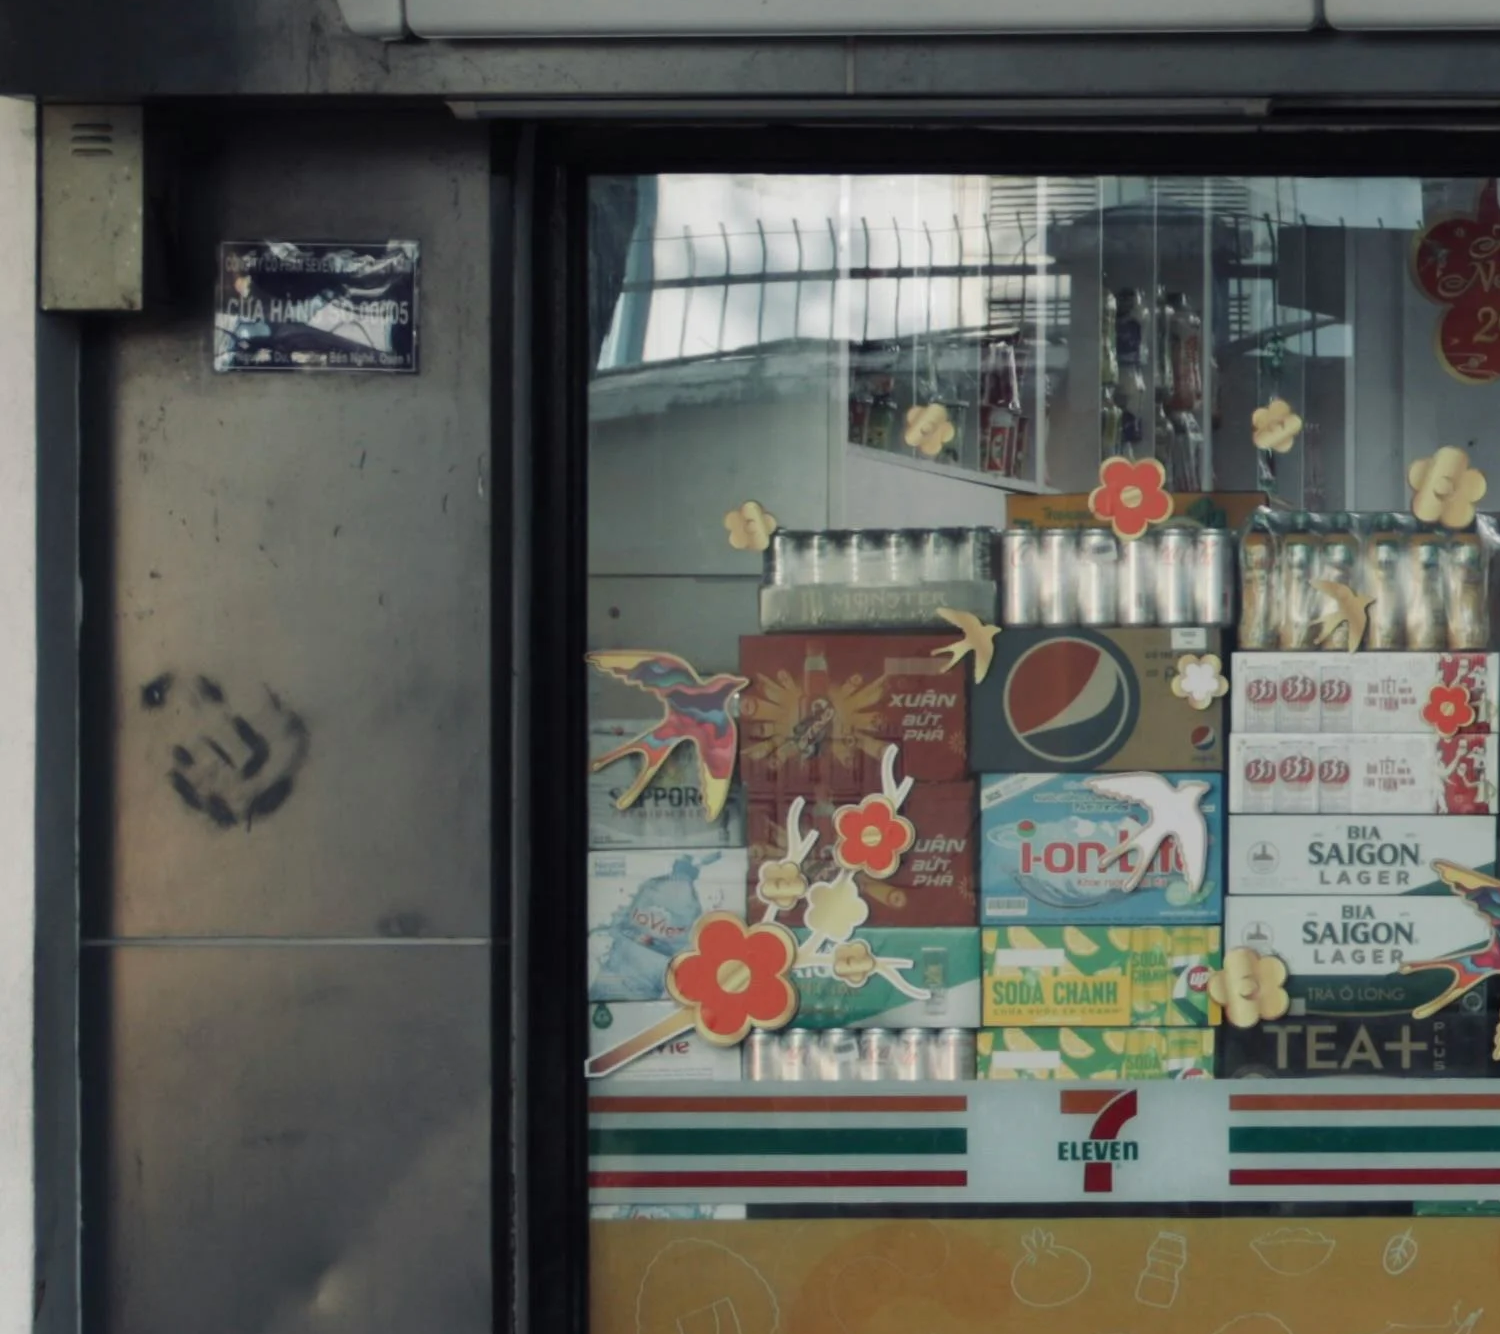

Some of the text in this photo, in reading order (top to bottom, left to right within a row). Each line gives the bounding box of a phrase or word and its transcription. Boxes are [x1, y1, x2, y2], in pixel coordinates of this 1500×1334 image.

[888, 685, 956, 708] XUÂN
[1347, 825, 1381, 840] BIA
[1307, 842, 1420, 866] SAIGON
[1319, 870, 1410, 885] LAGER
[1341, 904, 1376, 919] BIA
[1302, 920, 1415, 945] SAIGON
[1313, 949, 1404, 964] LAGER
[991, 980, 1118, 1006] SODA CHANH
[1357, 986, 1405, 1001] LONG
[1262, 1024, 1428, 1069] TEA+
[1432, 1021, 1446, 1071] PLUS
[1060, 1089, 1137, 1193] 7
